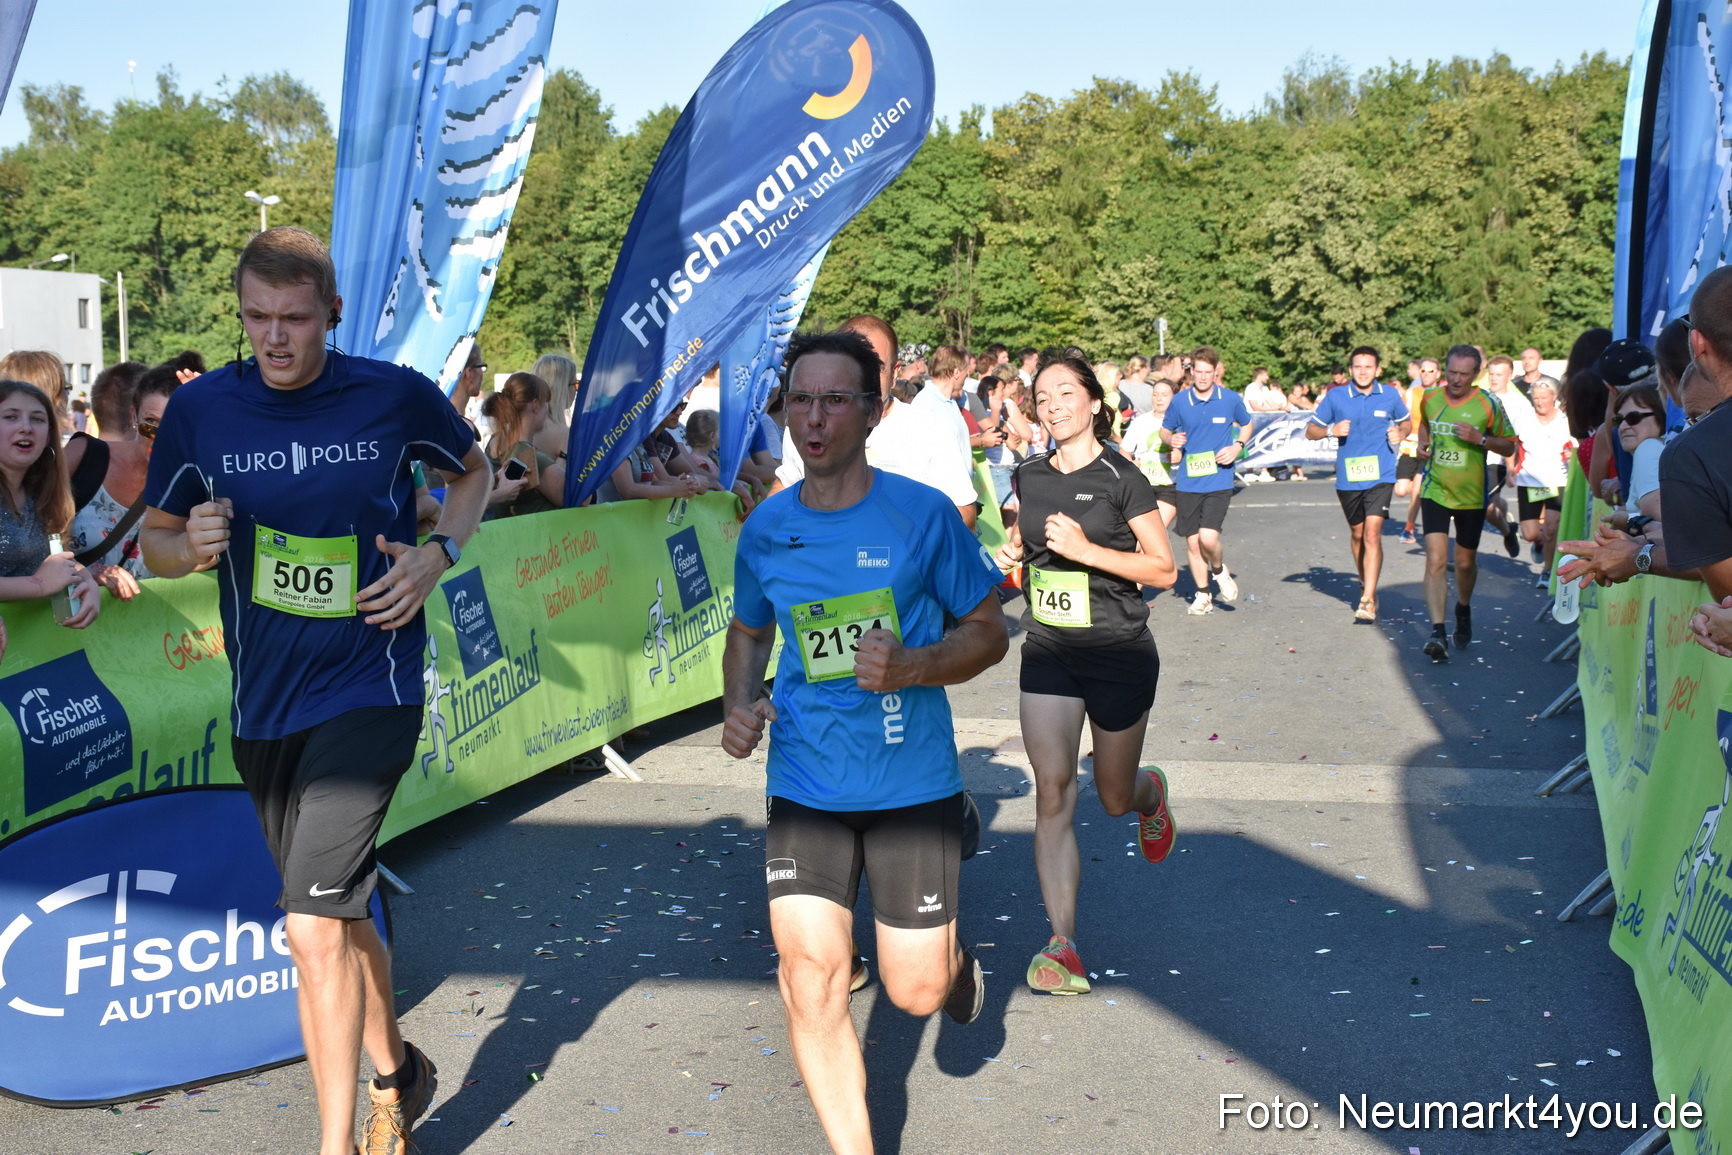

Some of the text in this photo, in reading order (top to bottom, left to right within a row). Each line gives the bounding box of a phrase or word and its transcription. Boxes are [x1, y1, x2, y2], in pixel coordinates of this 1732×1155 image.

[755, 96, 912, 250] Druck und Medien
[621, 131, 832, 348] Frischmann
[577, 337, 704, 484] www.frischmann-net.de
[222, 440, 381, 475] EURO POLES
[1189, 460, 1212, 471] 1509
[1350, 463, 1375, 475] 1510
[1439, 450, 1459, 462] 223
[273, 560, 334, 596] 506
[858, 559, 889, 567] MEIKO
[273, 588, 333, 604] Reitner Fabian
[459, 600, 485, 627] Fischer
[1036, 588, 1072, 612] 746
[672, 586, 735, 656] firmenla
[450, 628, 542, 736] firmenlauf
[36, 694, 103, 735] Fischer
[51, 714, 108, 747] AUTOMOBILE
[874, 689, 905, 745] me
[458, 718, 503, 763] neumarkt
[65, 908, 291, 996] Fische
[99, 966, 300, 1027] AUTOMOBIL
